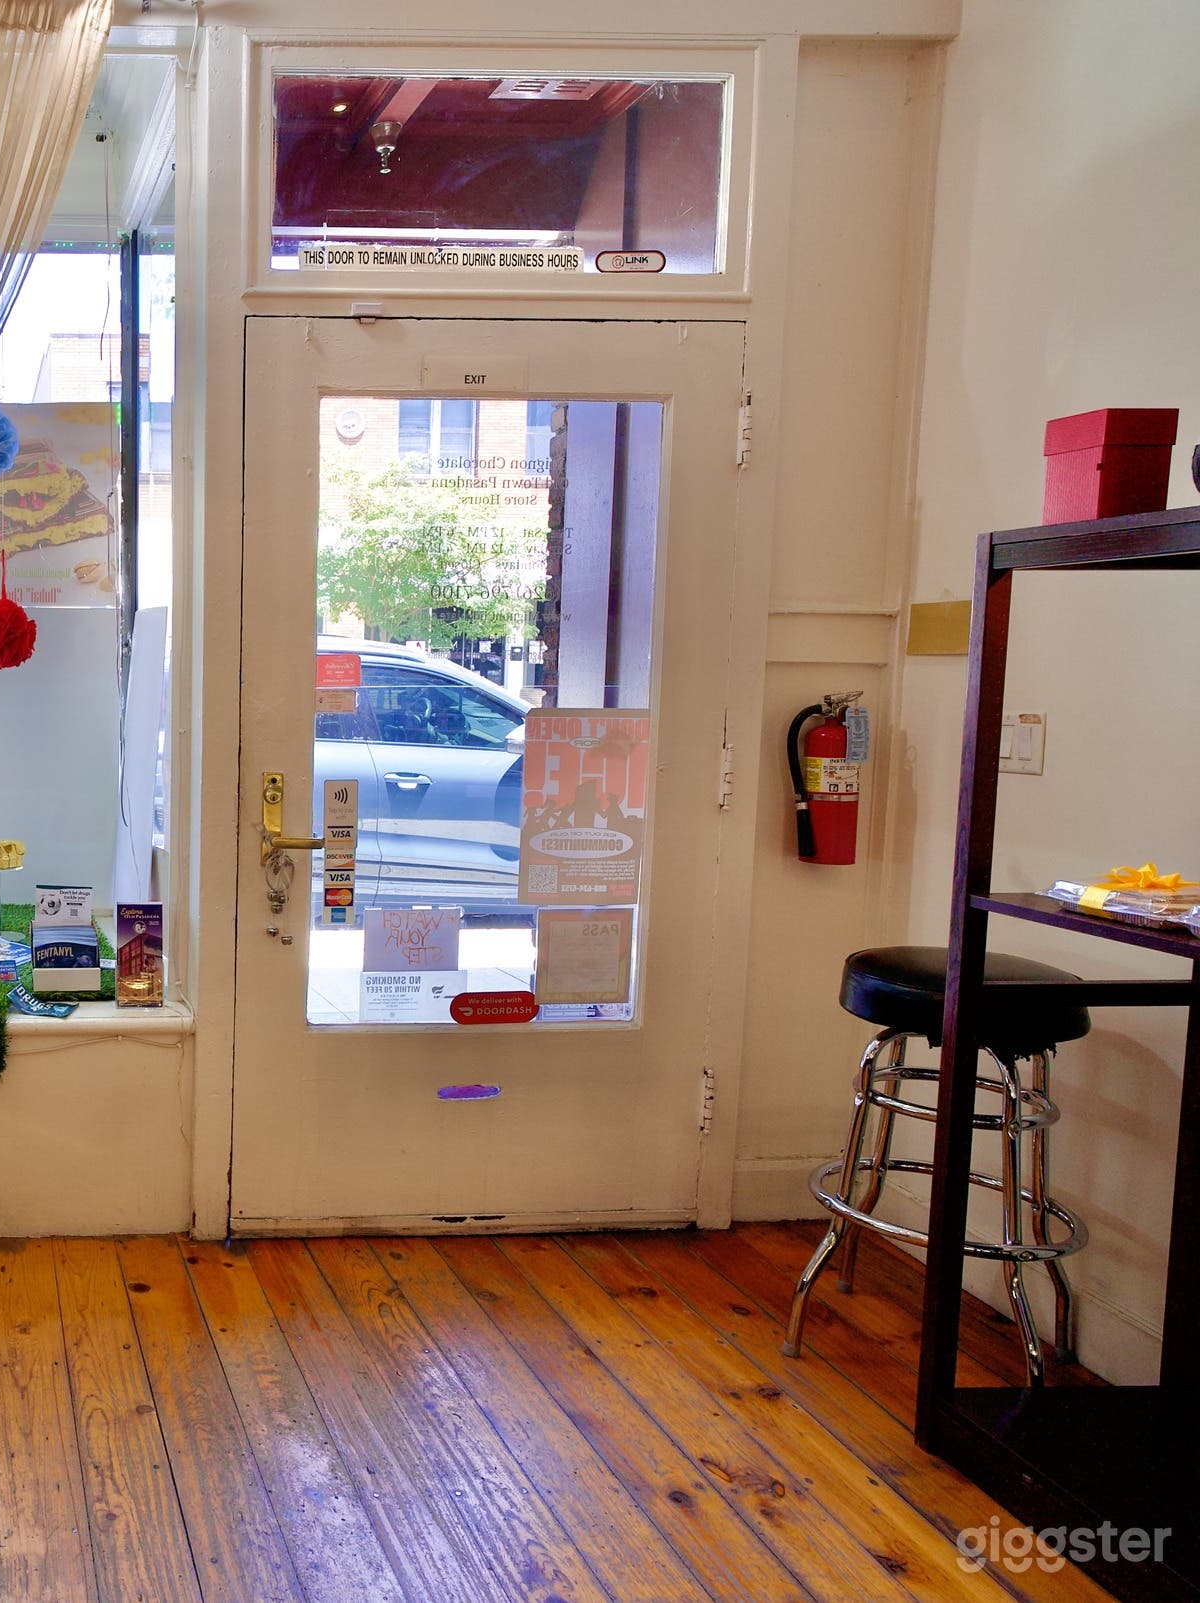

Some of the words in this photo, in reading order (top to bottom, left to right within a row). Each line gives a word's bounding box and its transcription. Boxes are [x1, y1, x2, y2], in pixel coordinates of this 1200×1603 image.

[304, 250, 324, 264] THIS
[328, 251, 354, 264] DOOR
[358, 251, 370, 264] TO
[373, 251, 407, 265] REMAIN
[410, 252, 459, 265] UNLOCKED
[462, 252, 496, 266] DURING
[499, 253, 544, 266] BUSINESS
[547, 253, 579, 267] HOURS
[625, 256, 649, 264] LINK
[463, 373, 487, 385] EXIT
[330, 830, 352, 838] VISA
[329, 873, 351, 882] VISA
[36, 946, 74, 961] FENTANYL
[16, 985, 53, 1010] DRUGS
[477, 1006, 532, 1015] DOORDASH
